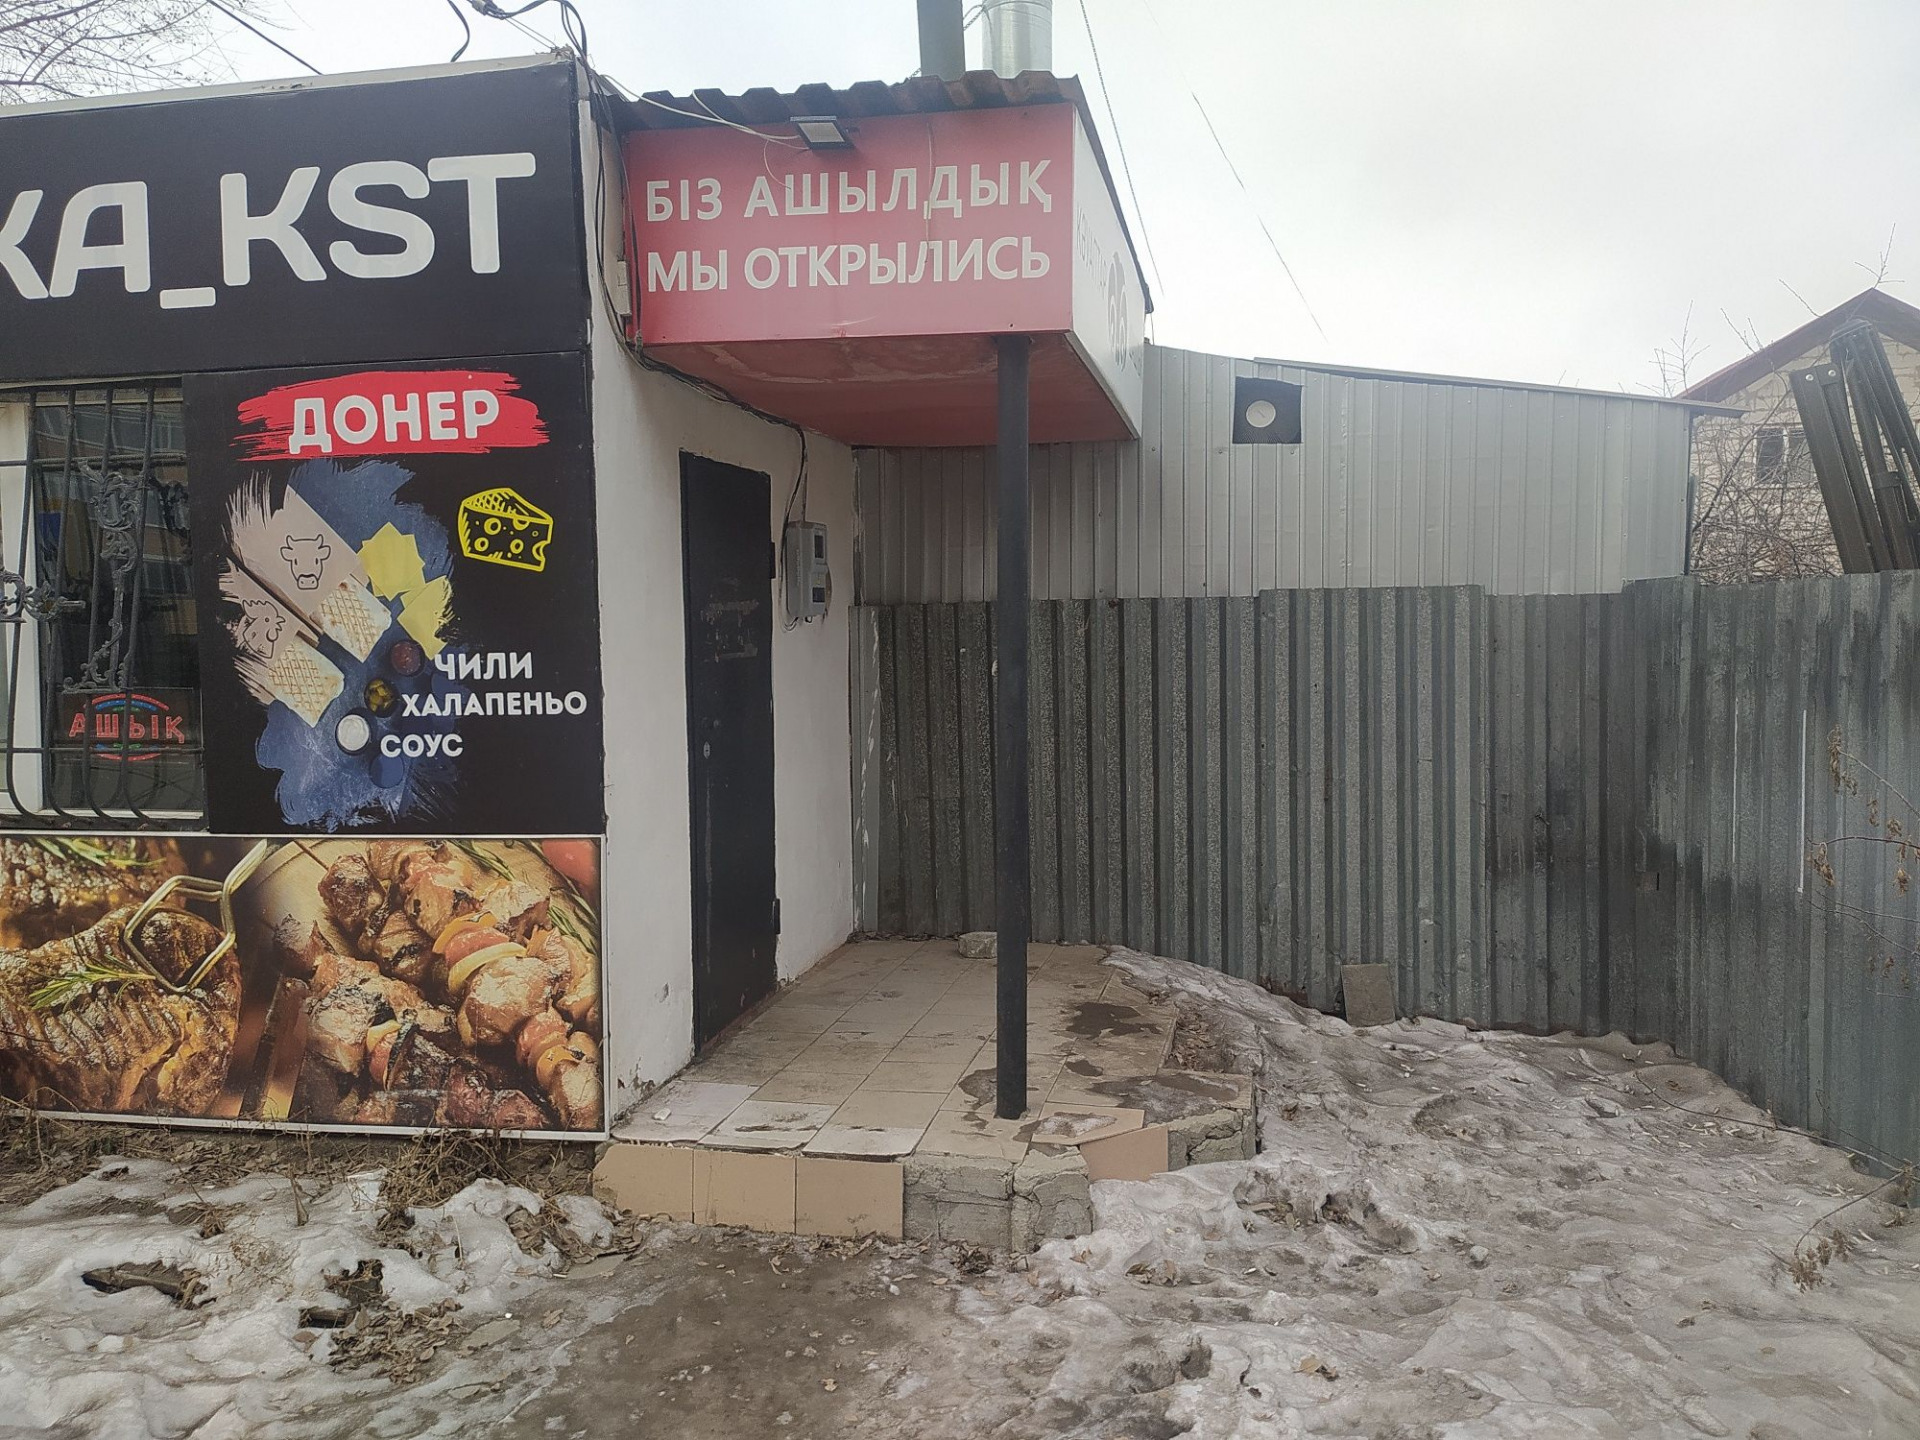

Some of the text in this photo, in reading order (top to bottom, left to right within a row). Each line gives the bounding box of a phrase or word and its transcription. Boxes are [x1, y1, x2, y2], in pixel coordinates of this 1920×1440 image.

[646, 159, 1052, 222] БІЗ АШЫЛДЫҚ
[647, 249, 728, 292] МЫ
[744, 235, 1051, 290] ОТКРЫЛИСЬ
[288, 388, 500, 455] ДОНЕР
[434, 651, 533, 680] ЧИЛИ
[401, 690, 587, 718] ХАЛАПЕНЬО
[68, 712, 186, 744] АШЫҚ
[380, 733, 464, 758] СОУС
